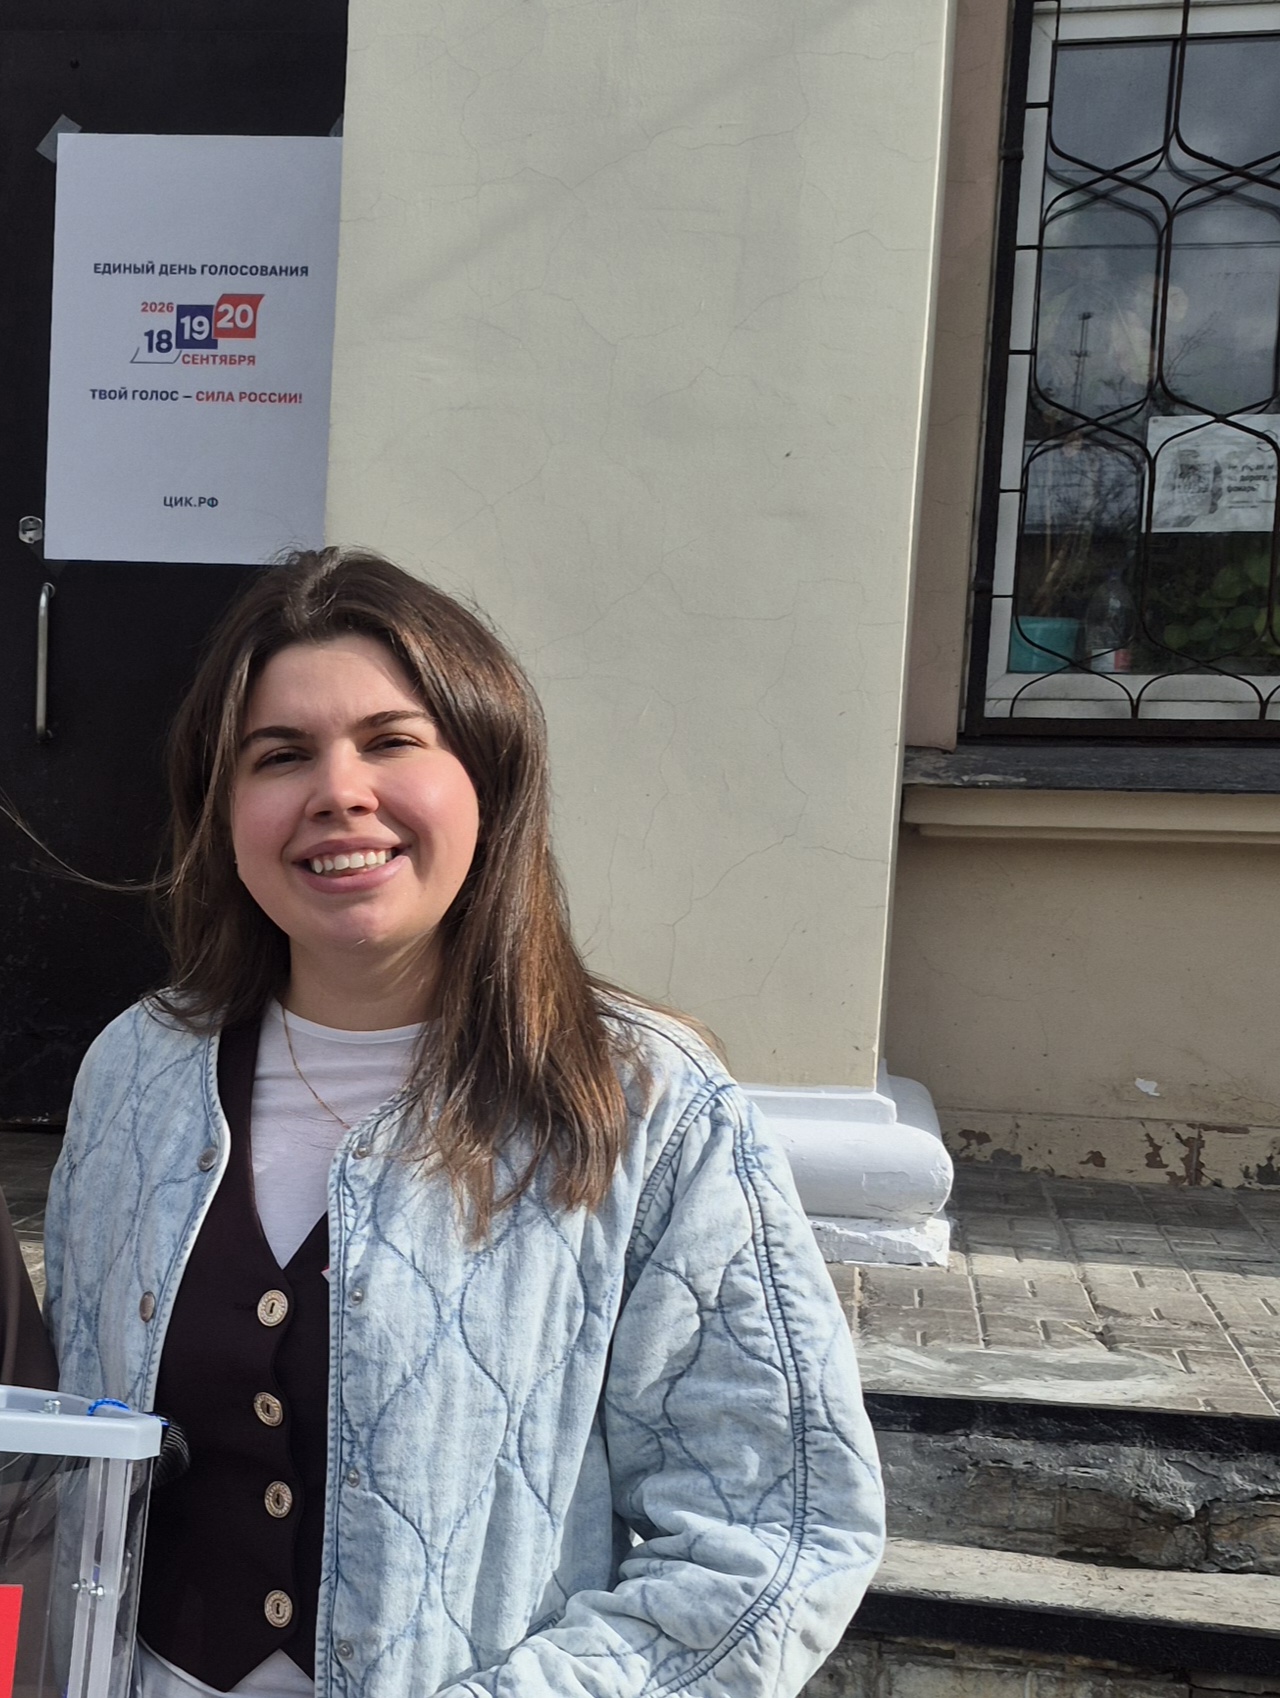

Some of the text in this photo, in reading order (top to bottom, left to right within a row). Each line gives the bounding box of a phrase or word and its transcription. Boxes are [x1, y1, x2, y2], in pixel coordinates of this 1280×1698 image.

[93, 260, 309, 277] ЕДИНЫЙ ДЕНЬ ГОЛОСОВАНИЯ
[140, 301, 175, 313] 2026
[144, 303, 254, 354] 18 19 20
[181, 353, 256, 366] СЕНТЯБРЯ
[90, 386, 129, 401] ТВОЙ
[131, 388, 179, 402] ГОЛОС
[195, 390, 235, 403] СИЛА
[238, 391, 303, 404] РОССИИ!
[163, 495, 219, 509] ЦИК.РФ
